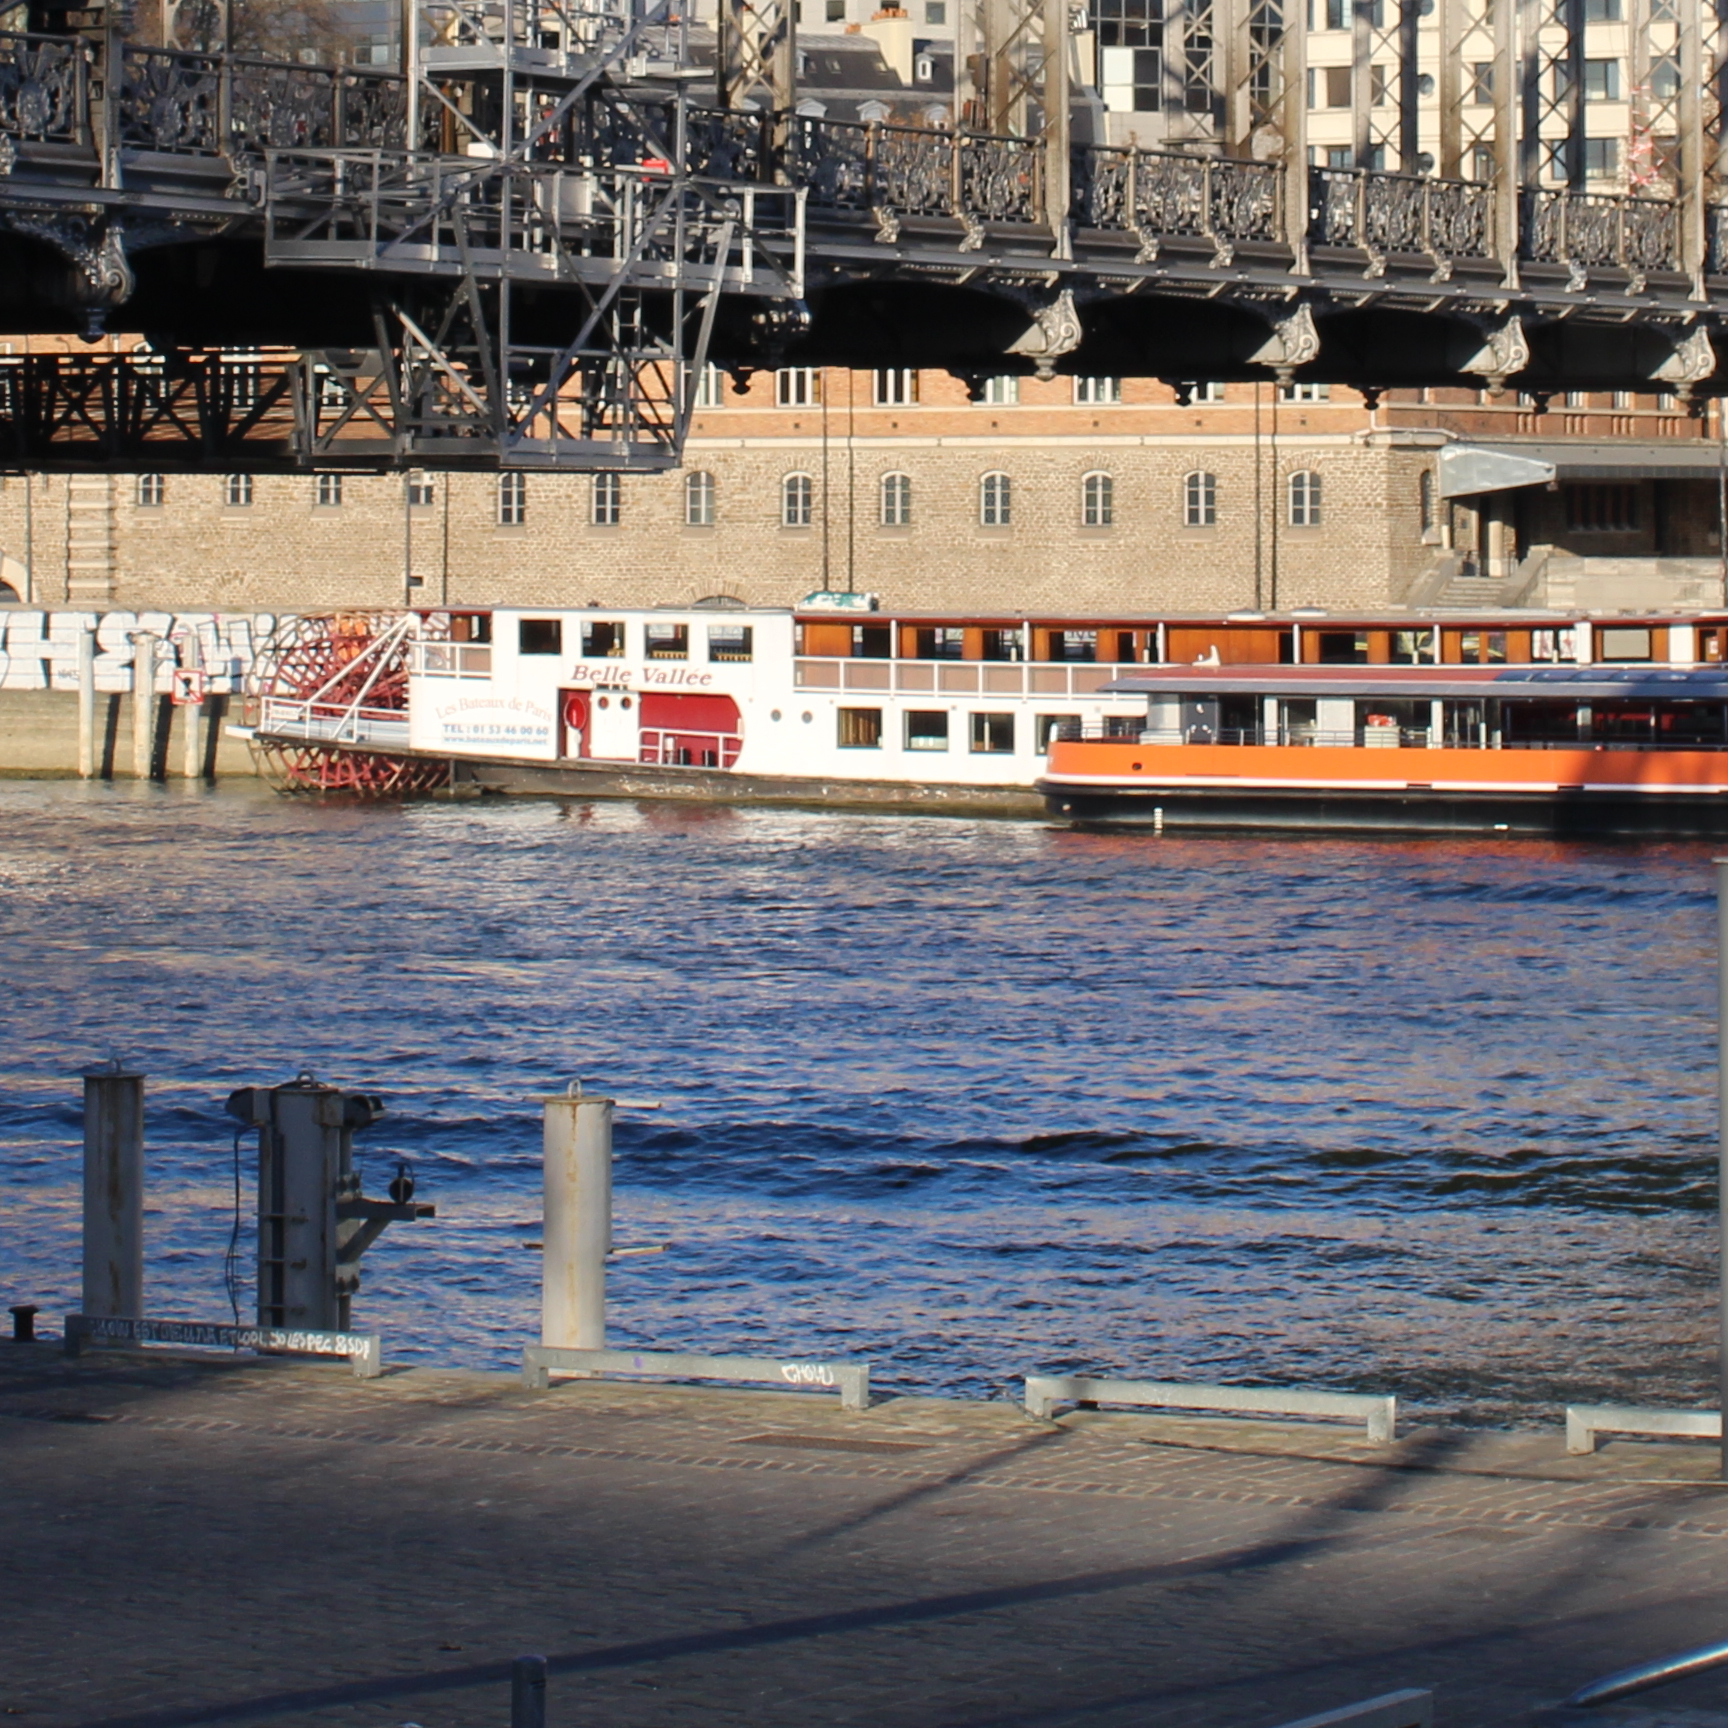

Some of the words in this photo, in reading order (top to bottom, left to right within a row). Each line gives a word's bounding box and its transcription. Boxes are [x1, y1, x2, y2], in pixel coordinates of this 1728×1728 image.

[570, 663, 633, 683] Belle
[641, 666, 714, 687] Vallée
[434, 703, 457, 720] Les
[458, 697, 506, 712] Bateaux
[507, 697, 523, 711] de
[524, 699, 554, 722] Paris
[443, 724, 464, 734] TEL
[472, 725, 485, 734] 01
